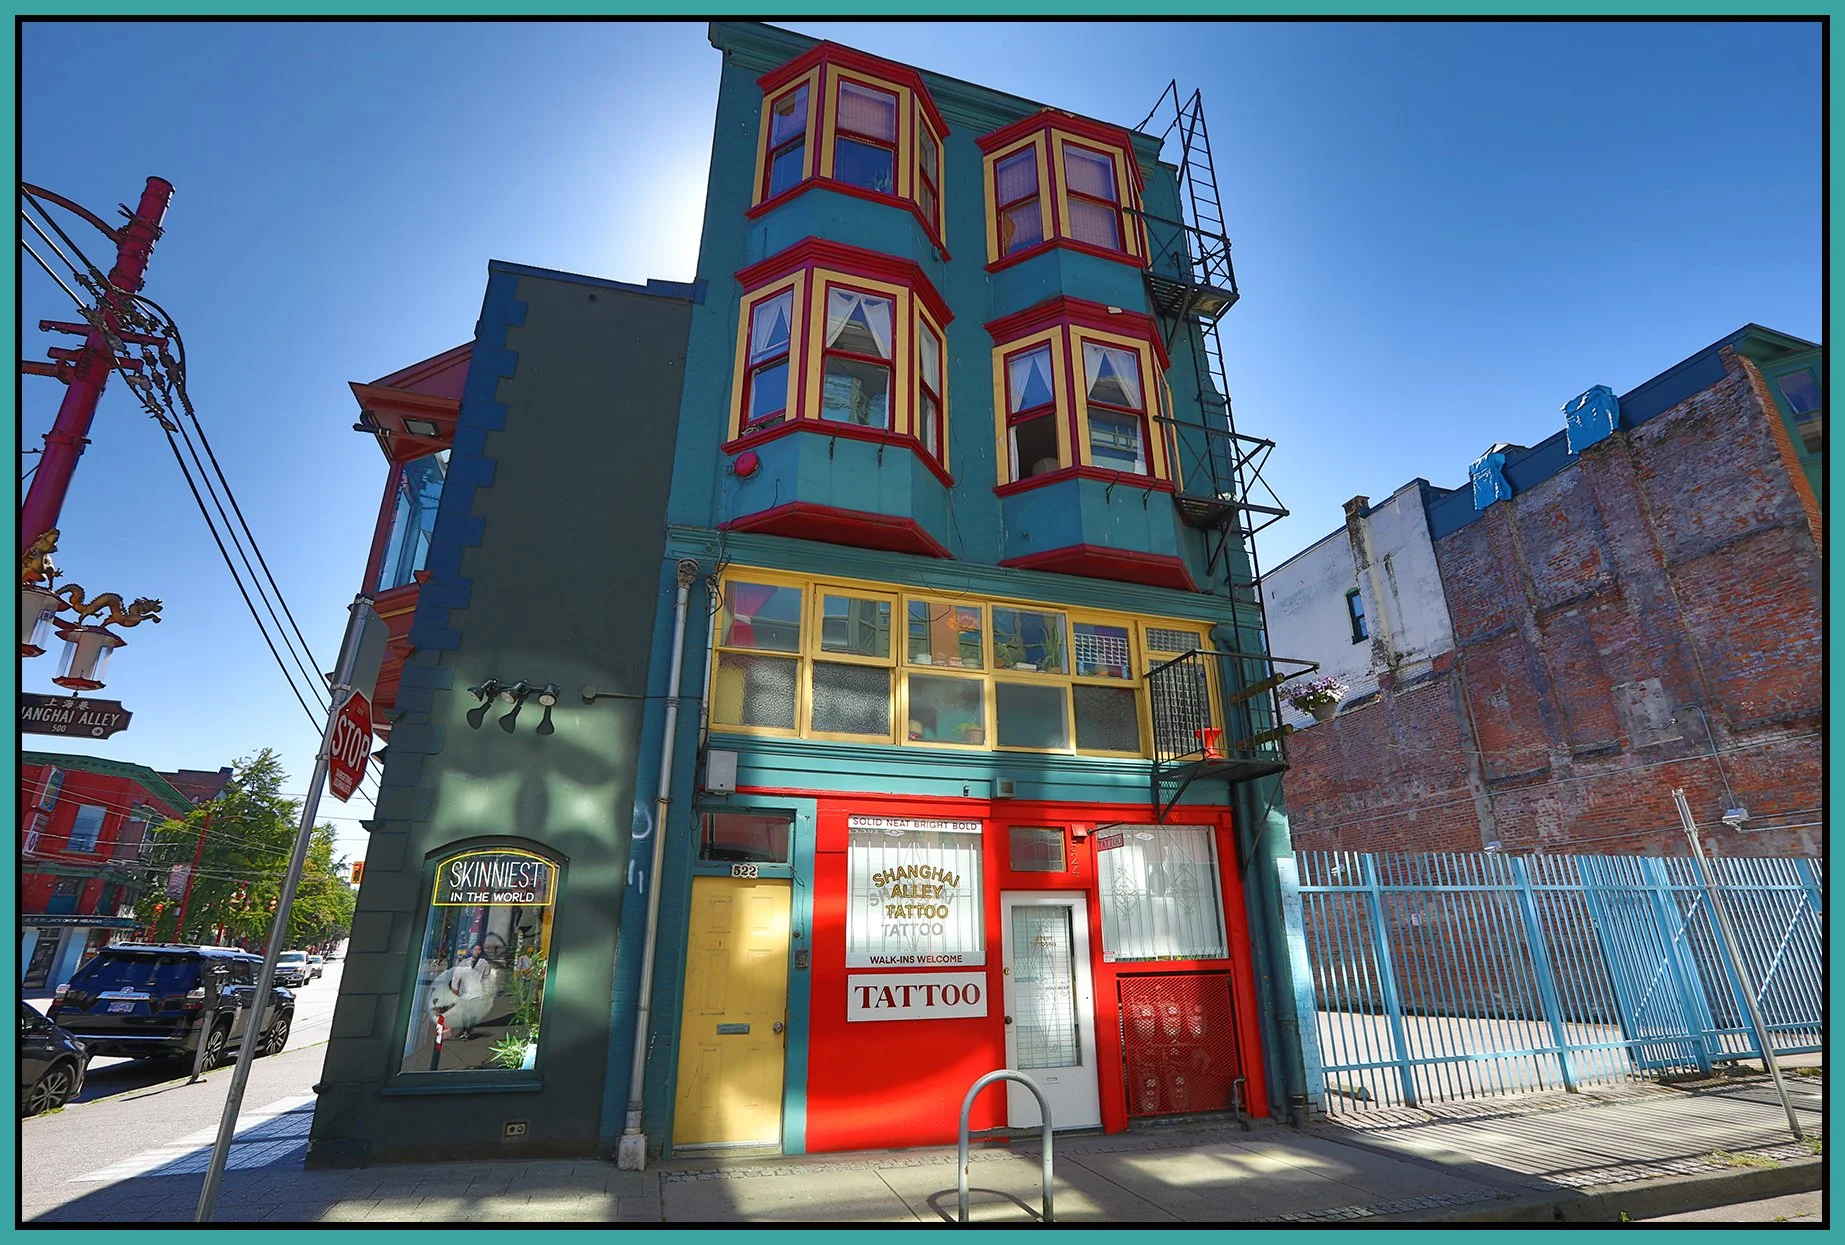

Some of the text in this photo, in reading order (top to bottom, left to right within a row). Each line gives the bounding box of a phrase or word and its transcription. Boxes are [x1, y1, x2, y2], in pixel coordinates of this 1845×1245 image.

[22, 706, 120, 727] ANGHAI ALLEY
[51, 724, 67, 732] 500
[332, 714, 370, 771] STOP
[852, 817, 977, 831] SOLID NEAT BRIGHT BOLD
[1098, 836, 1121, 851] TATTOO
[450, 861, 543, 888] SKINNIEST
[733, 865, 757, 877] 522
[872, 864, 960, 888] SHANGHAI
[450, 892, 534, 902] IN THE WORLD
[891, 884, 943, 899] ALLEY
[886, 904, 949, 919] TATTOO
[870, 954, 962, 964] WALK-INS WELCOME
[854, 983, 981, 1009] TATTOO
